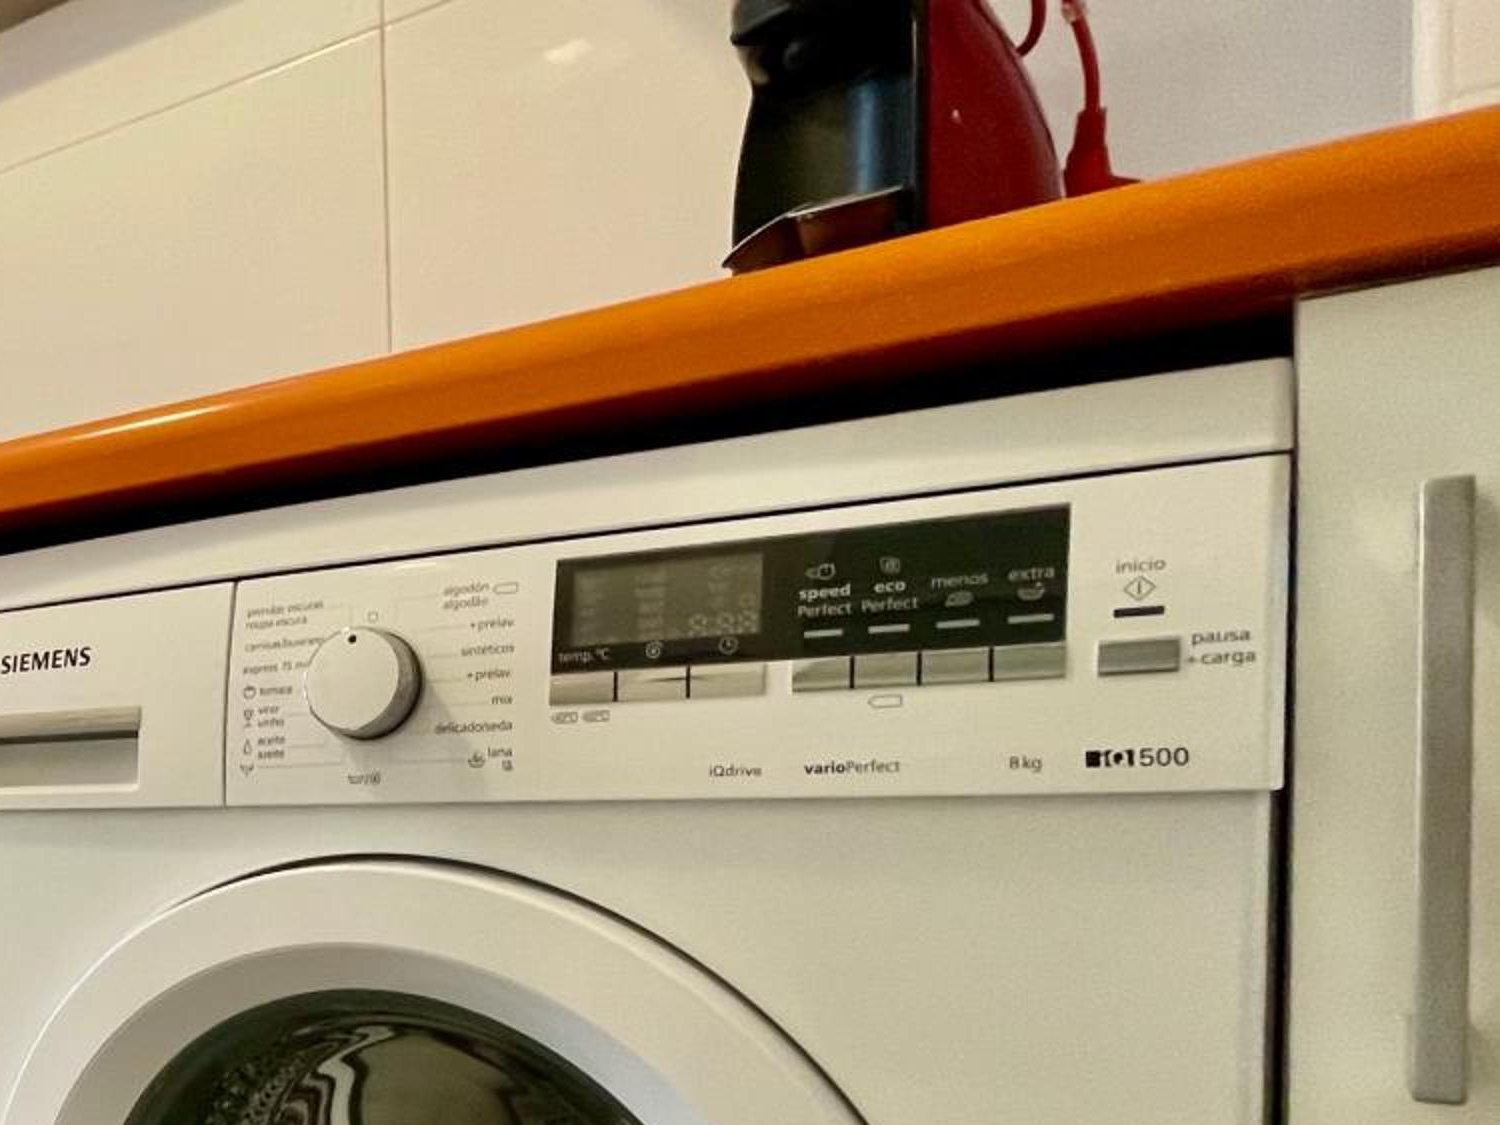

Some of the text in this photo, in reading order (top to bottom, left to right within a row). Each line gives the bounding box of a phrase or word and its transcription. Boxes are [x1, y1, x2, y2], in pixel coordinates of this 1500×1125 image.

[1008, 566, 1055, 582] extra
[1115, 559, 1166, 574] inicio
[874, 579, 907, 594] eco
[931, 573, 989, 589] menos
[799, 584, 851, 602] speed
[798, 602, 852, 618] Perfect
[861, 597, 919, 613] Perfect
[1191, 630, 1251, 646] pausa
[1, 646, 92, 675] SIEMENS
[708, 763, 763, 778] iQdrive
[804, 759, 900, 775] varioPerfect
